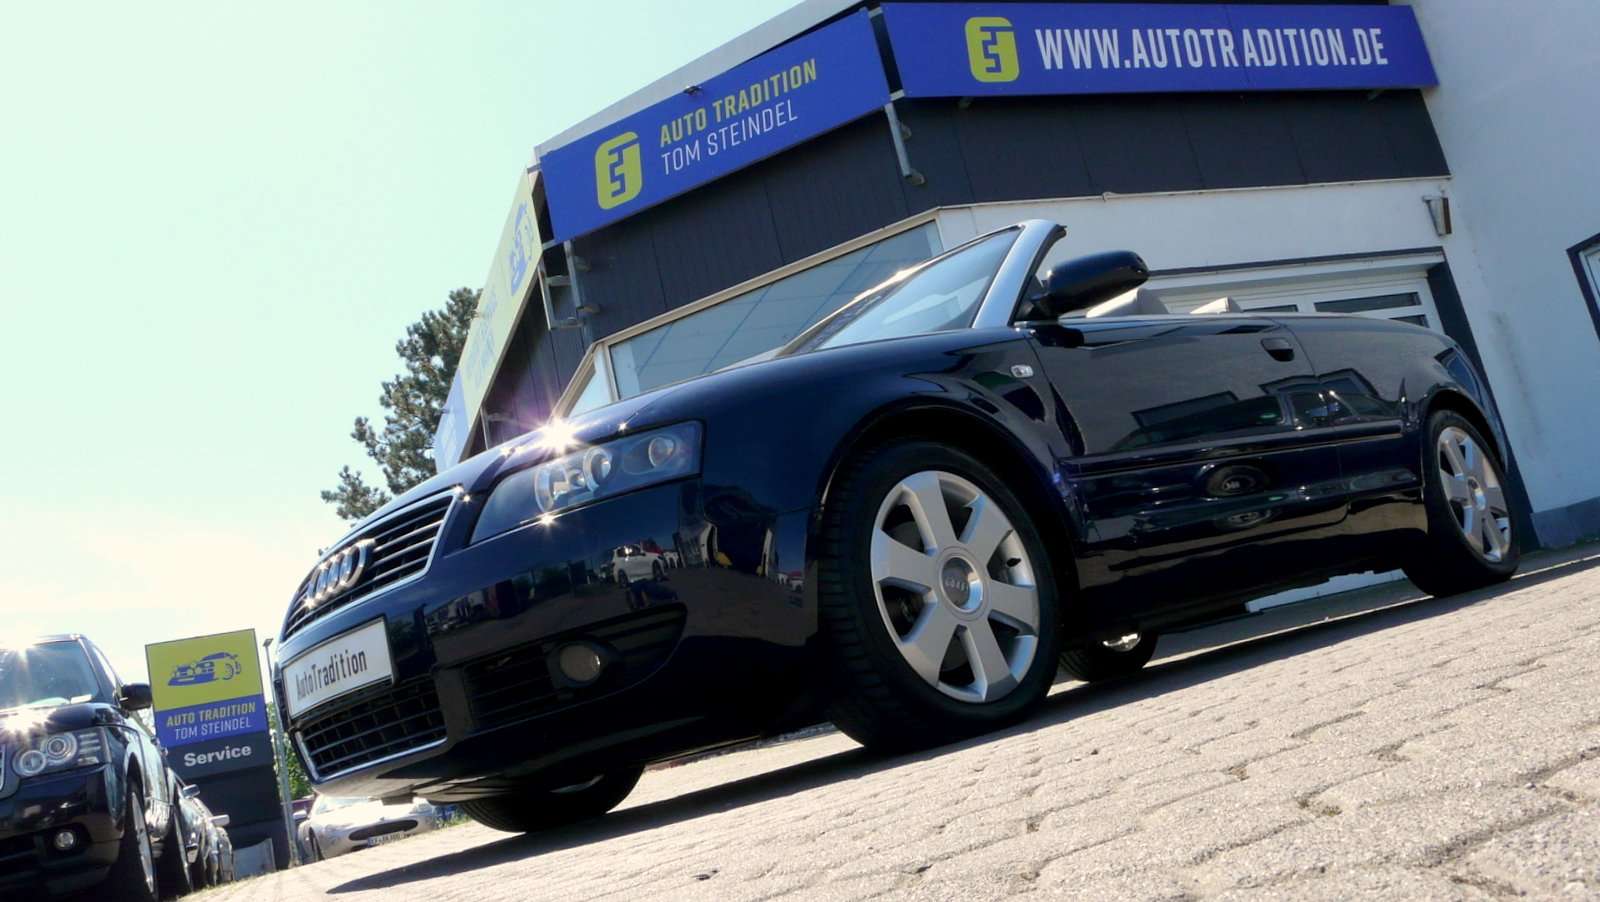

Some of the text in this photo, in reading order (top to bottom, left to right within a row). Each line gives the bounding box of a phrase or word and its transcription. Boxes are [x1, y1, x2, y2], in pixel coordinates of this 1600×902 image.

[1035, 28, 1388, 70] WWW.AUTOTRADITION.DE
[659, 58, 817, 148] AUTO TRADITION
[661, 99, 798, 175] TOM STEINDEL
[295, 649, 368, 699] AutoTradition
[166, 702, 256, 727] AUTO TRADITION
[175, 717, 252, 740] TOM STEINDEL
[184, 745, 252, 767] Service
